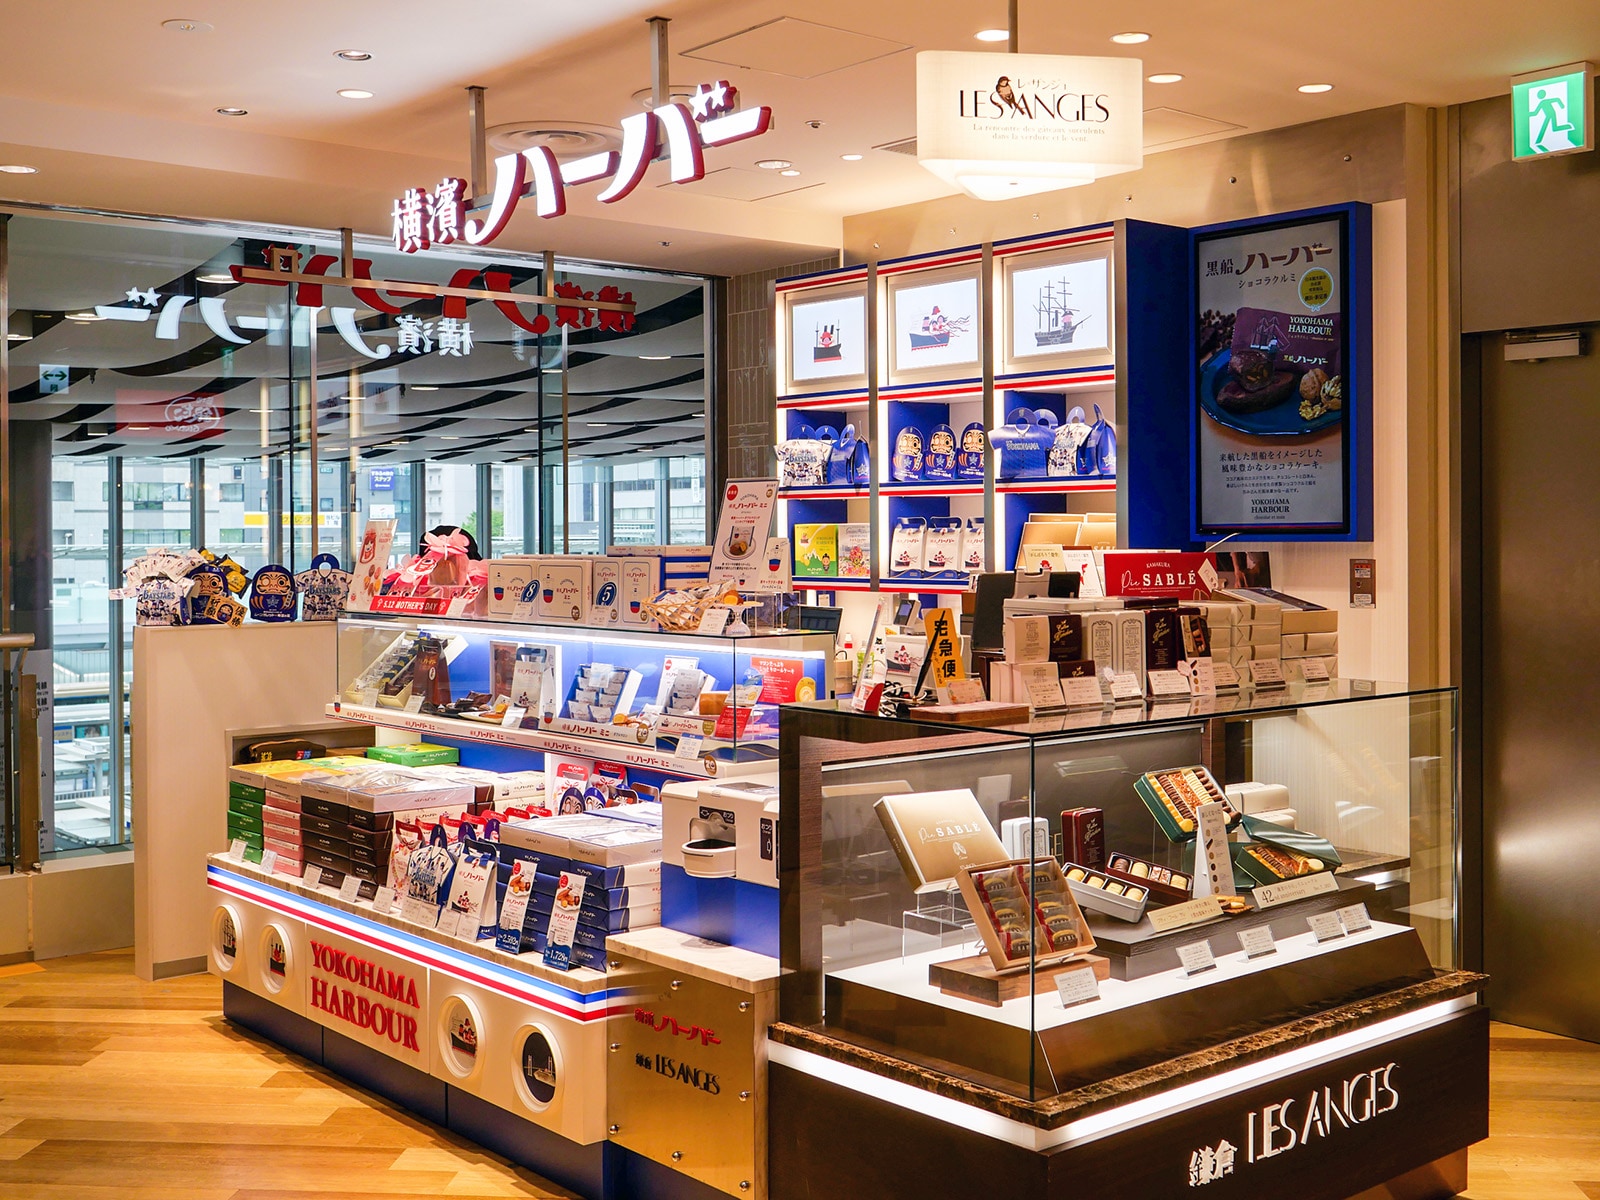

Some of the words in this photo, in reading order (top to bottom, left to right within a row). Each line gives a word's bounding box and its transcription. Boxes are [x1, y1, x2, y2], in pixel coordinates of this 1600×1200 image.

[960, 90, 1004, 120] LES
[1011, 93, 1110, 123] ANGES
[1238, 273, 1297, 289] ショコラクルミ
[1289, 316, 1334, 327] YOKOHAMA
[1288, 324, 1332, 336] HARBOUR
[1219, 449, 1323, 462] 来航した黒船をイメージした
[1251, 505, 1290, 513] HARBOUR
[1142, 570, 1197, 586] SABLÉ
[141, 589, 175, 601] BAYSTARS
[309, 584, 341, 596] BAYSTARS
[526, 583, 536, 597] 8
[602, 587, 611, 601] 5
[395, 601, 424, 611] MOTHER'S
[424, 603, 438, 611] DAY
[934, 620, 957, 678] 宅急便
[722, 811, 734, 819] おつり
[761, 822, 773, 831] おつり
[936, 822, 982, 838] SABLÉ
[309, 940, 421, 1009] YOKOHAMA
[309, 976, 420, 1053] HARBOUR
[656, 1054, 677, 1079] LES
[676, 1063, 721, 1095] ANGES
[1188, 1139, 1238, 1188] 鎌倉
[1248, 1098, 1297, 1164] LES
[1300, 1062, 1400, 1145] ANGES
